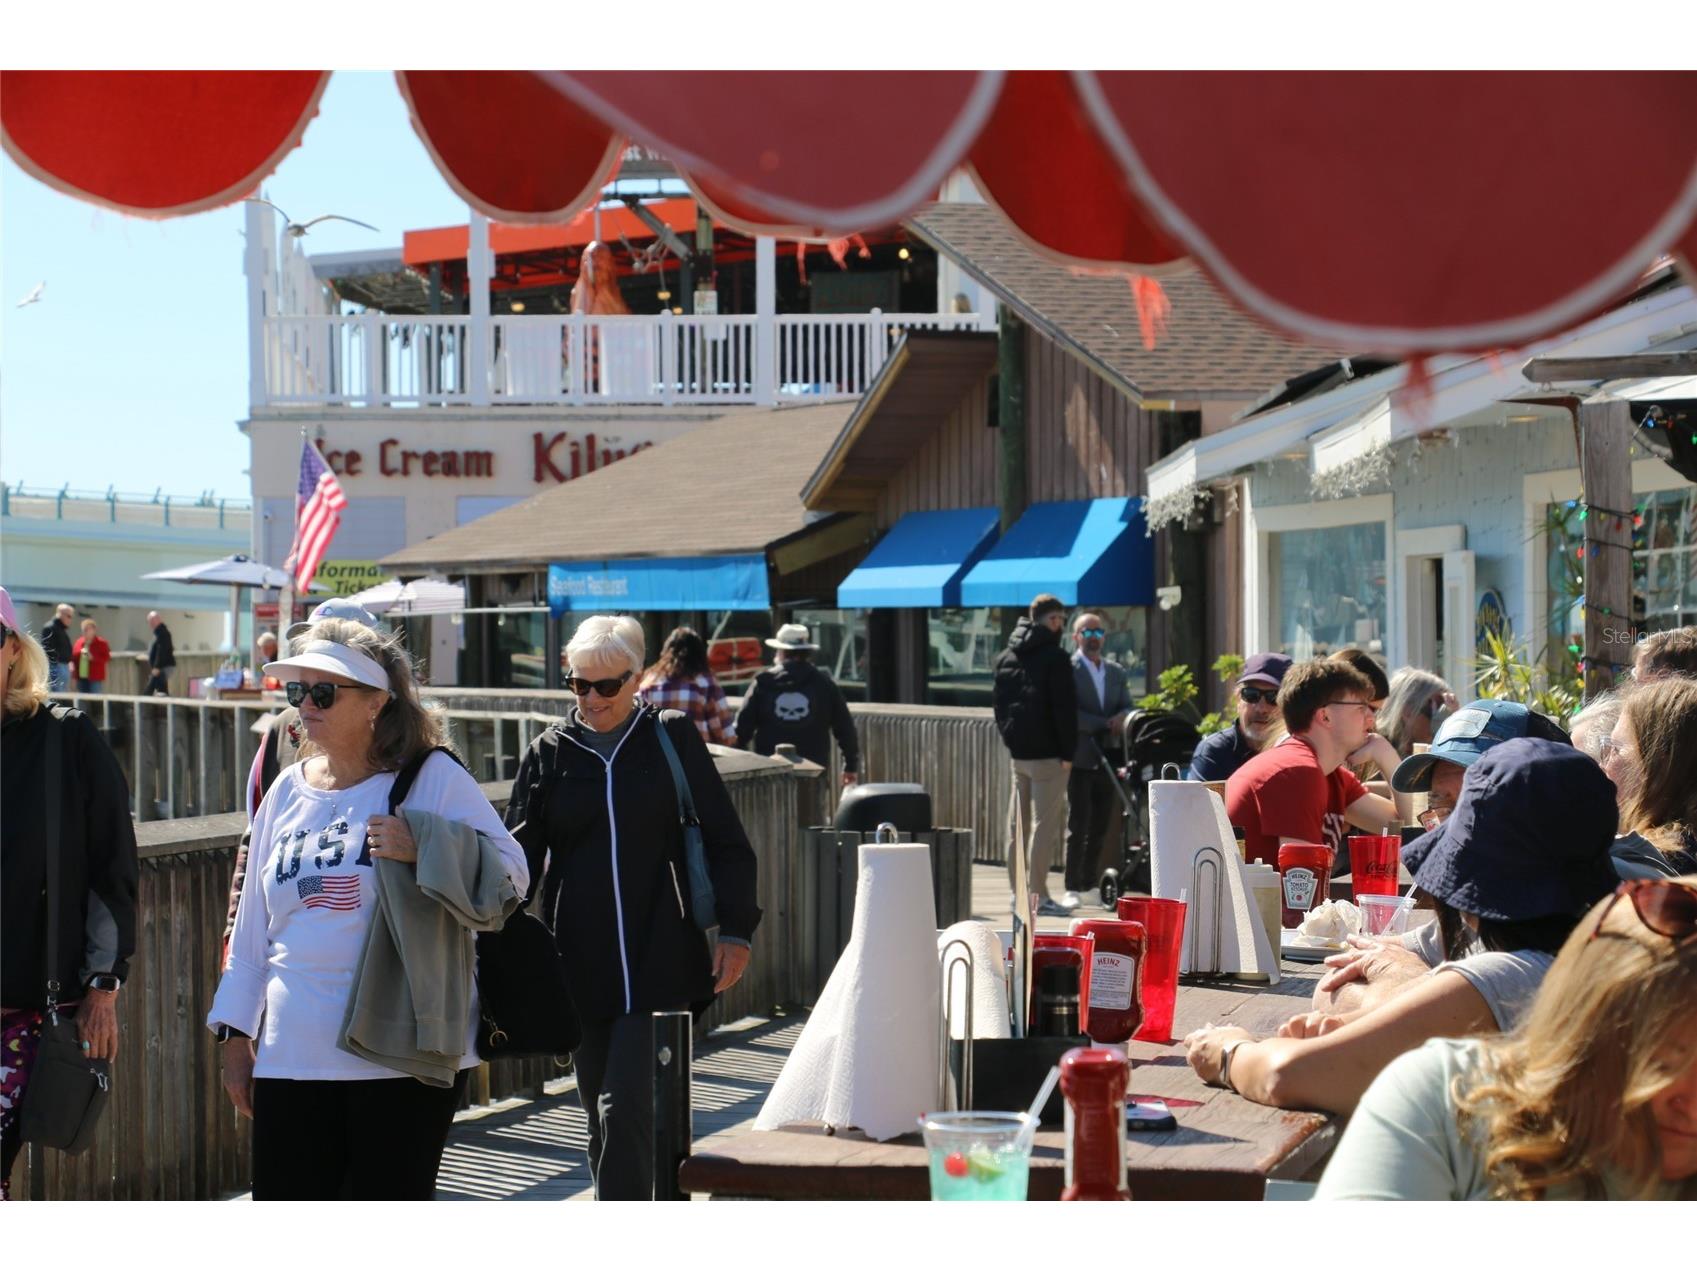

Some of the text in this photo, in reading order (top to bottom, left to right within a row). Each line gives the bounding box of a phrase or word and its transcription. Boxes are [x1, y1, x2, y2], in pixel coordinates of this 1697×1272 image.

[379, 437, 495, 477] Cream
[312, 561, 385, 578] forma
[1291, 871, 1308, 880] HEINZ
[1097, 957, 1121, 967] HEINZ
